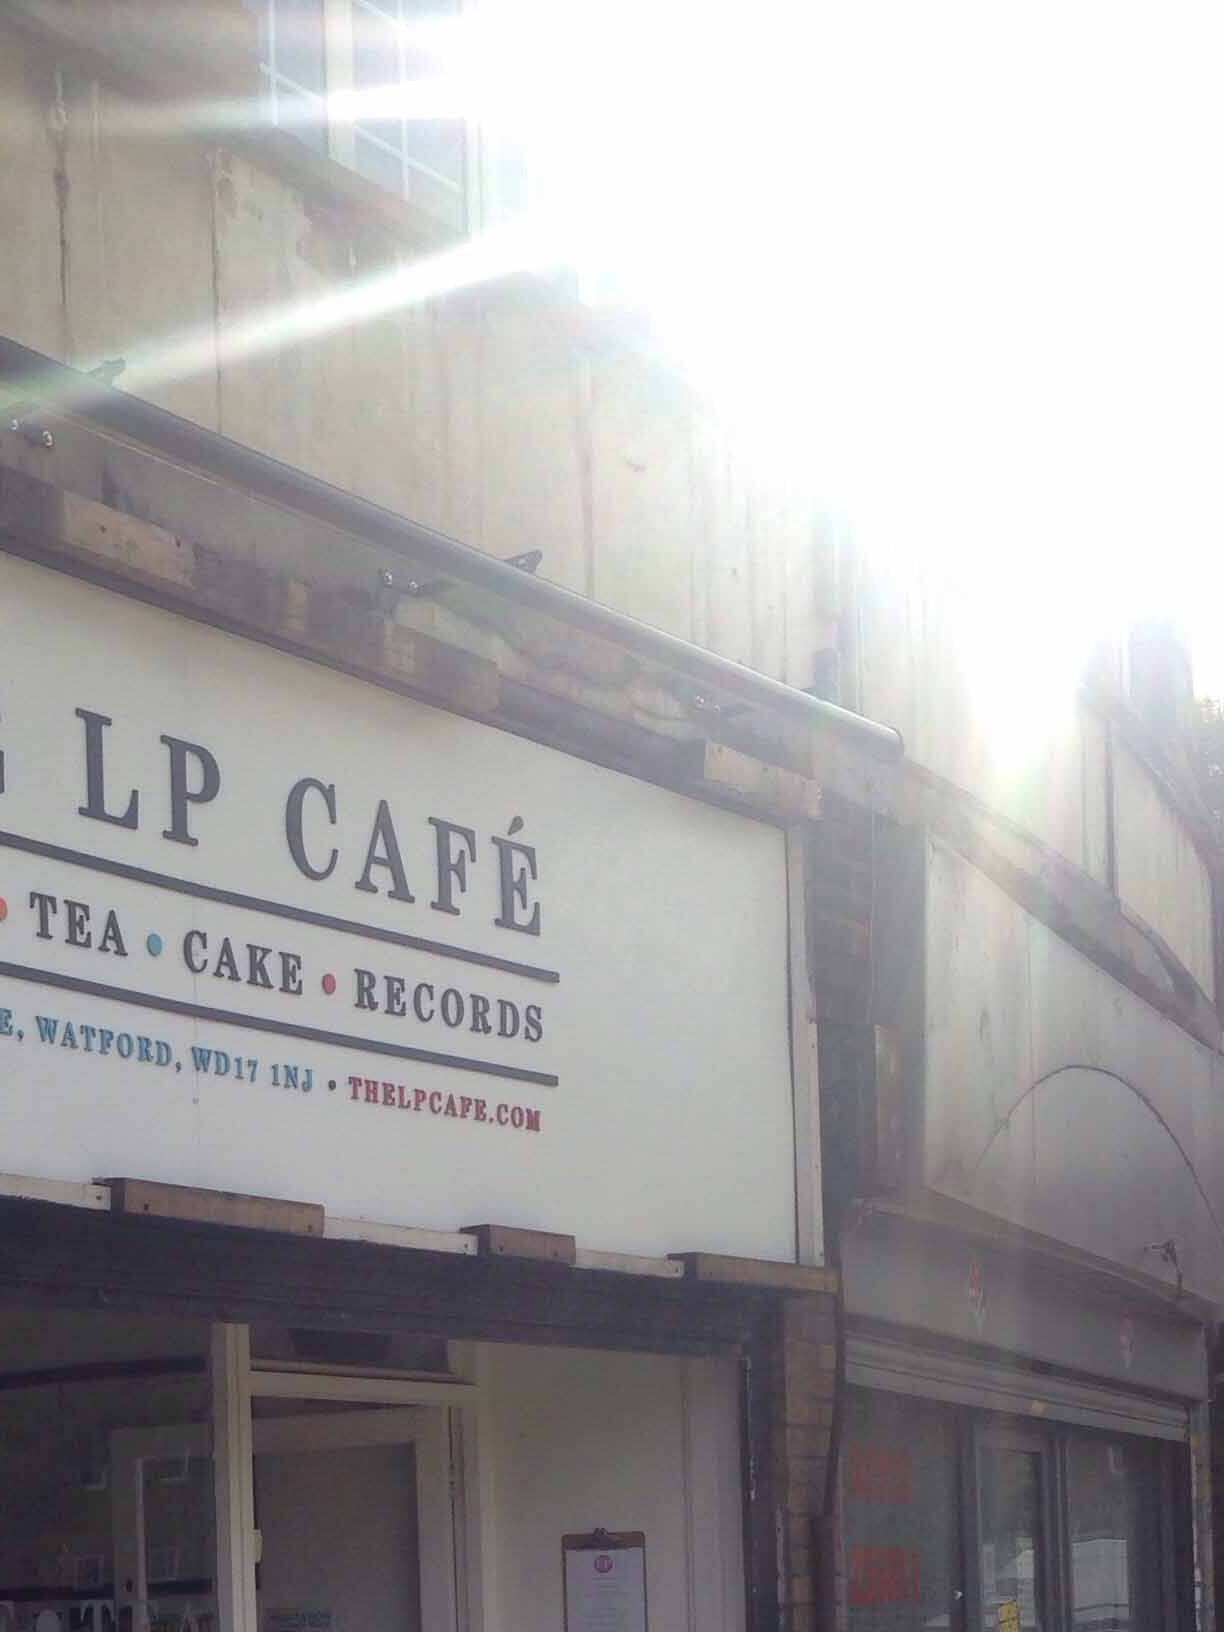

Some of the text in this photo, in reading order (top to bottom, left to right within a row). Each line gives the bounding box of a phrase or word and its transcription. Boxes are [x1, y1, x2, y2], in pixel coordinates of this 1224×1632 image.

[74, 706, 221, 847] LP
[284, 775, 543, 937] CAFÉ
[29, 890, 129, 958] TEA
[183, 929, 303, 997] CAKE
[353, 968, 545, 1042] RECORDS
[35, 1015, 183, 1074] WATFORD,
[191, 1045, 260, 1085] WD17
[271, 1063, 314, 1094] 1NJ
[347, 1075, 543, 1132] THELPCAFE.COM
